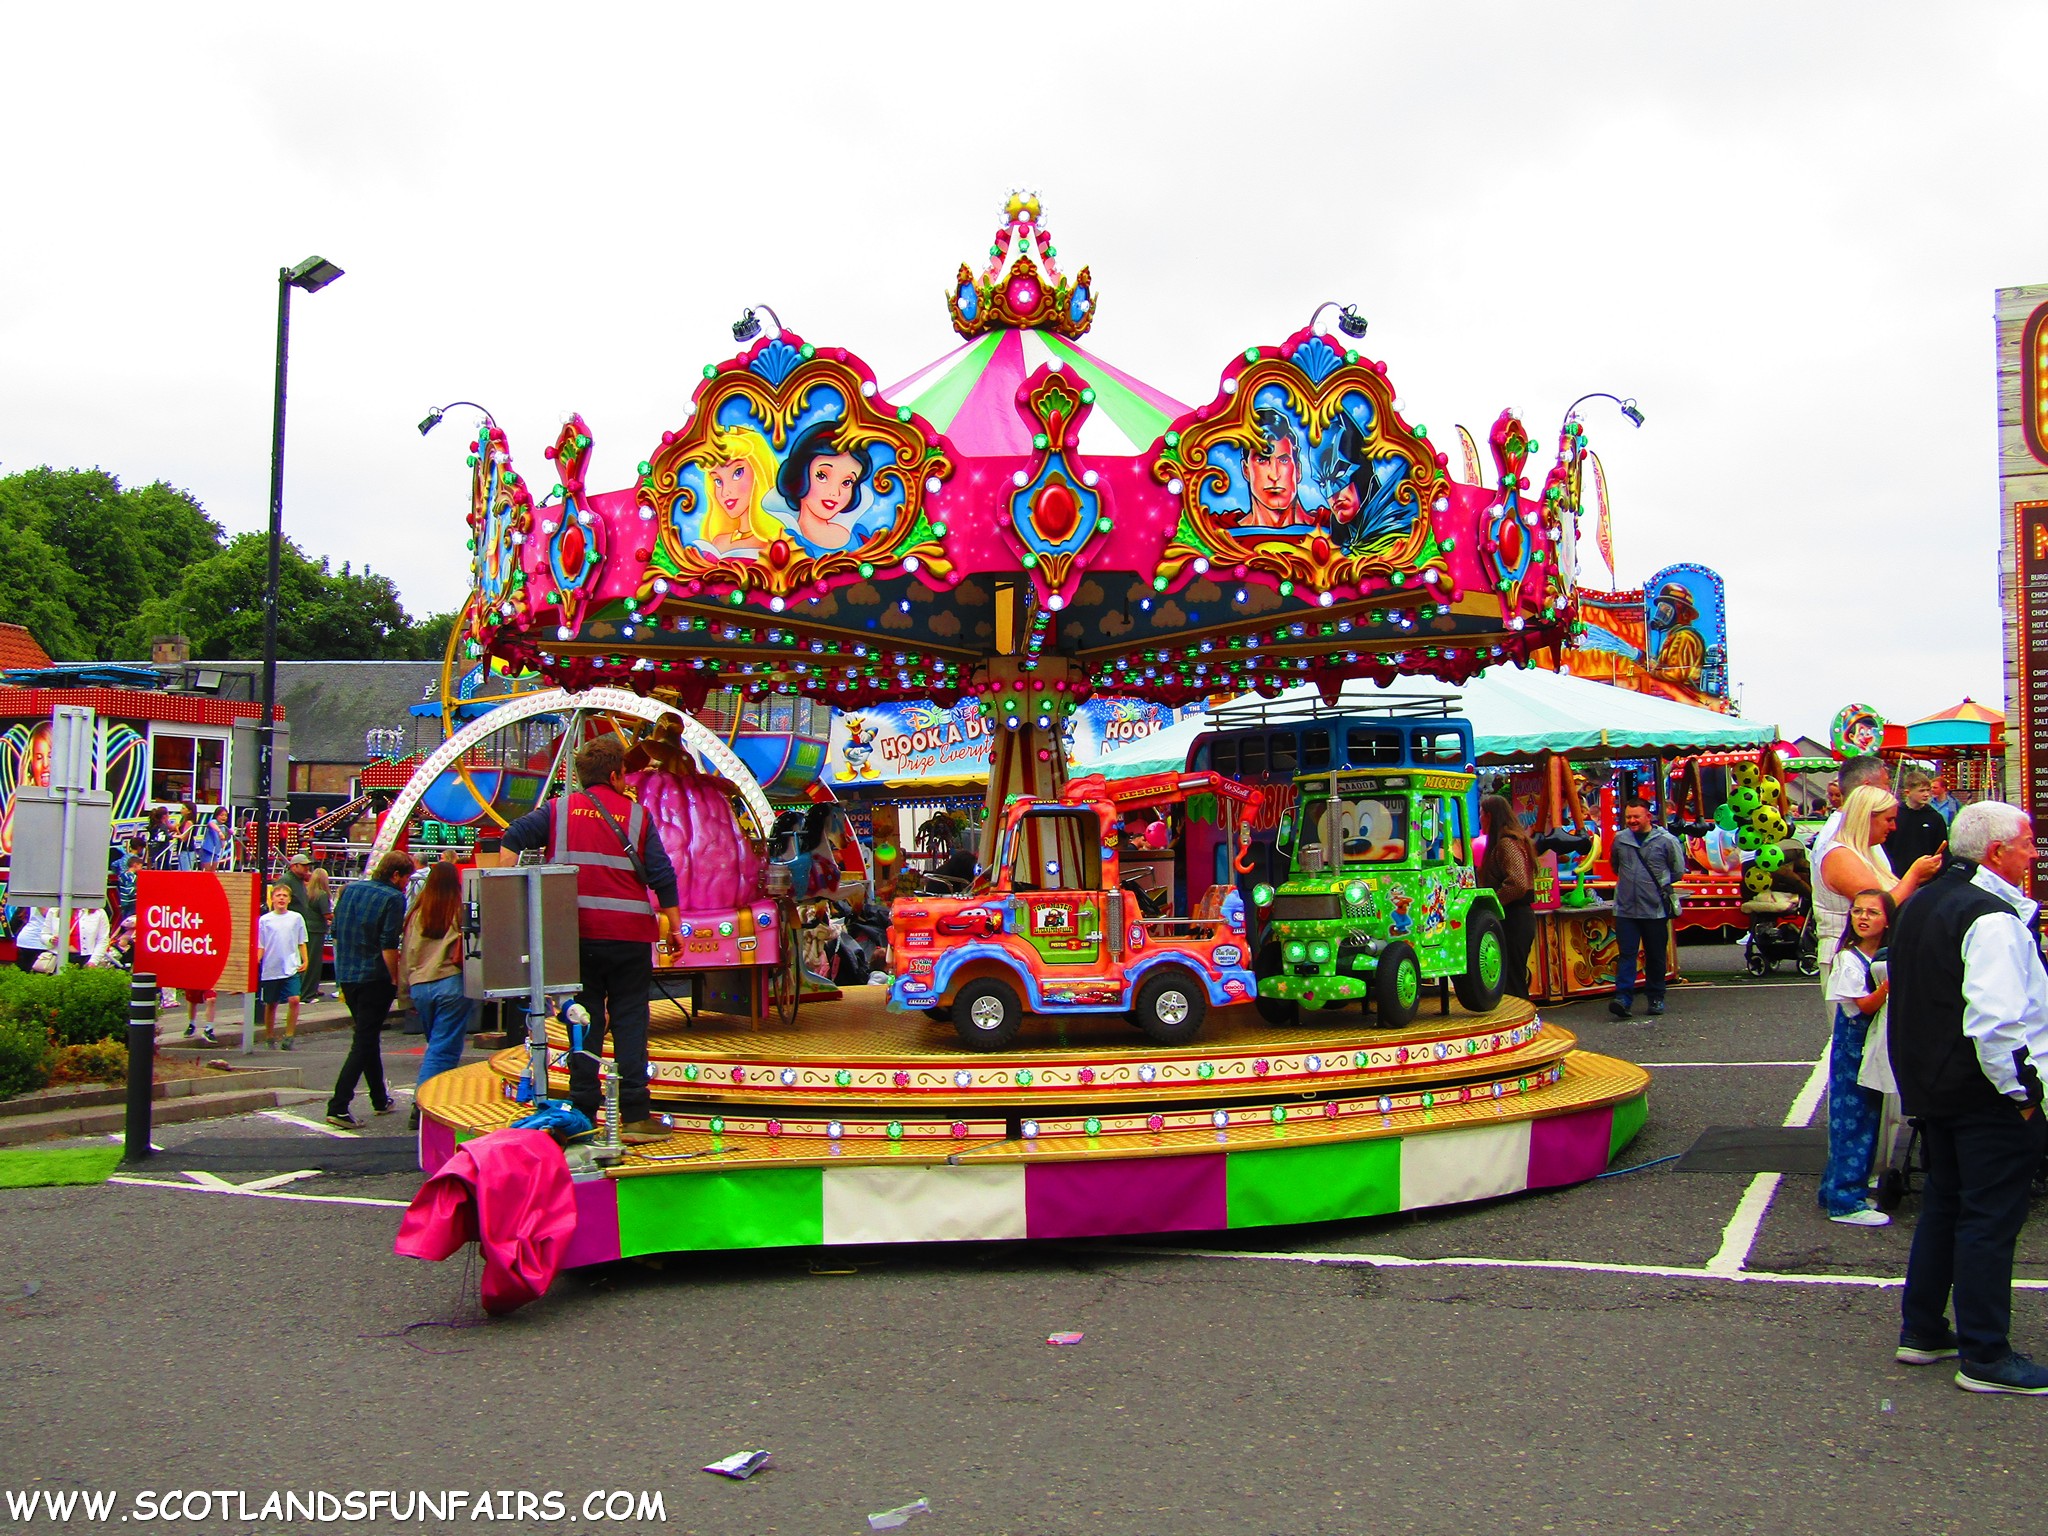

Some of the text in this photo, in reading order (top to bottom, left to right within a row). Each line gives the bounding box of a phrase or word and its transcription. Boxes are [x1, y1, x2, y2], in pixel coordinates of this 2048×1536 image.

[2032, 639, 2048, 647] FOOT
[1105, 722, 1162, 740] HOOK
[881, 727, 942, 760] HOOK
[947, 723, 963, 743] A
[897, 754, 936, 775] Prize
[2035, 767, 2048, 775] SUG
[1117, 783, 1172, 801] RESCUE
[1424, 775, 1470, 791] MICKEY
[570, 808, 626, 823] ATTENNT
[147, 905, 204, 929] Click+
[146, 929, 218, 955] Collect.
[910, 959, 931, 973] Stop
